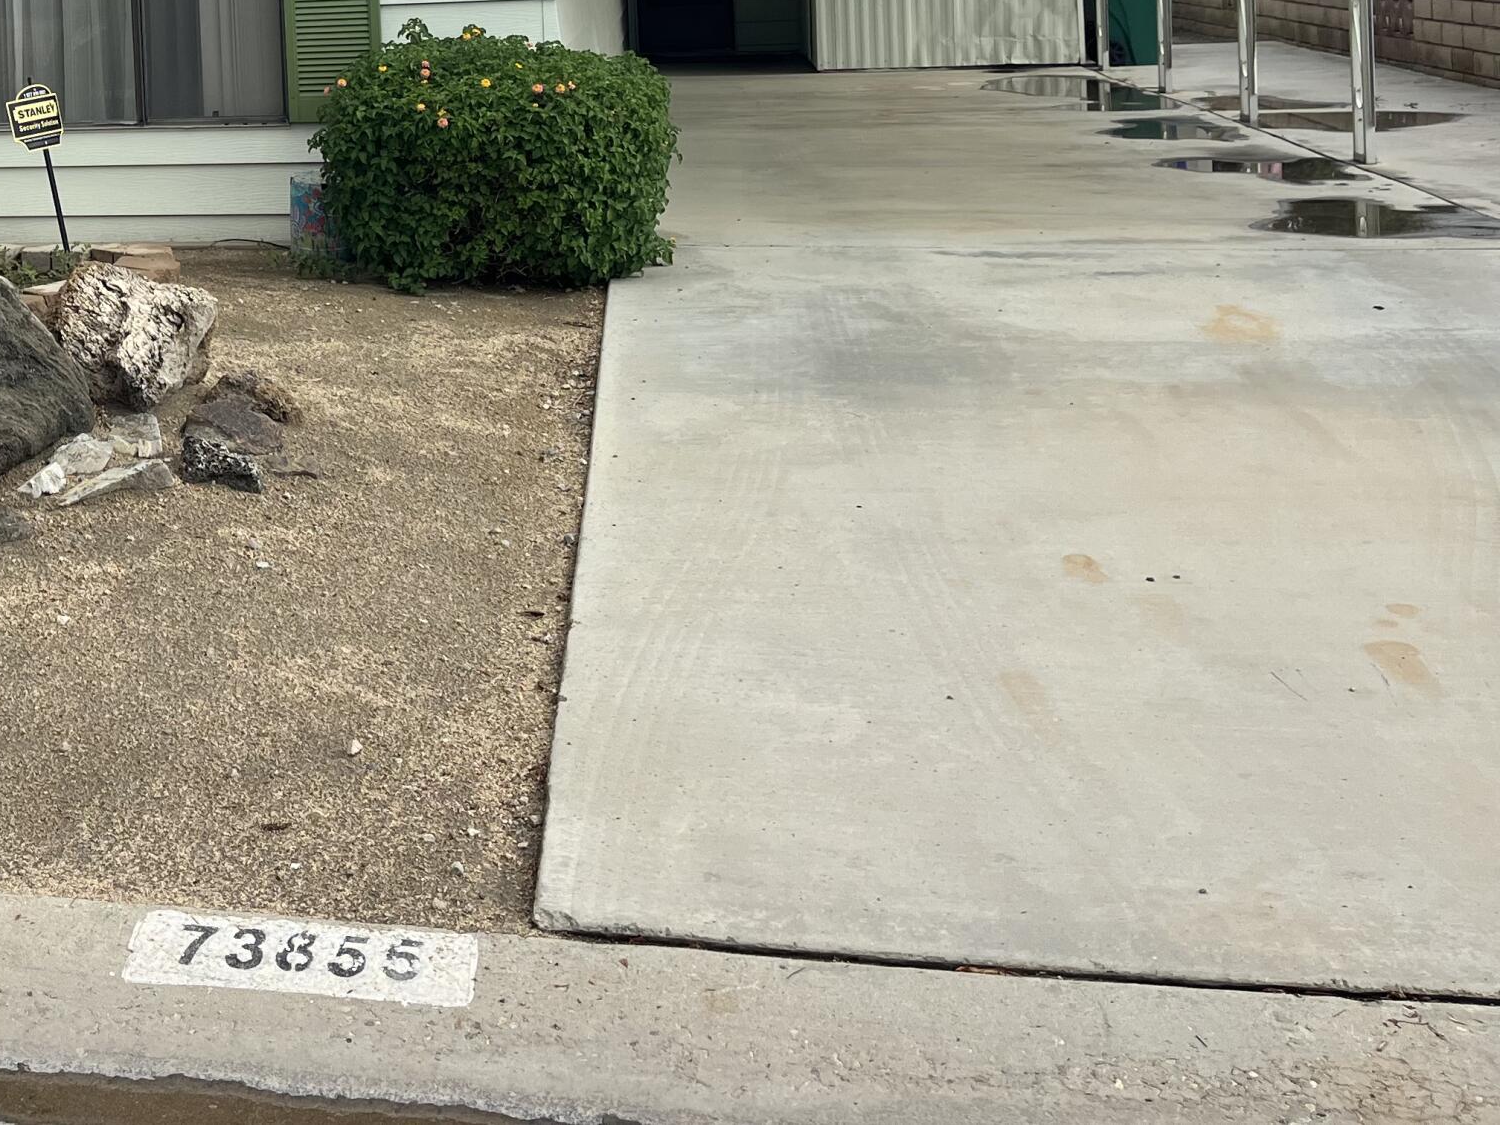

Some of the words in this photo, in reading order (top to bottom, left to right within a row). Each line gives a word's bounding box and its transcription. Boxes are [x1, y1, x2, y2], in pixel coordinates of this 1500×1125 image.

[18, 103, 54, 119] STANLEY
[19, 123, 41, 132] Security
[177, 923, 424, 981] 73855
